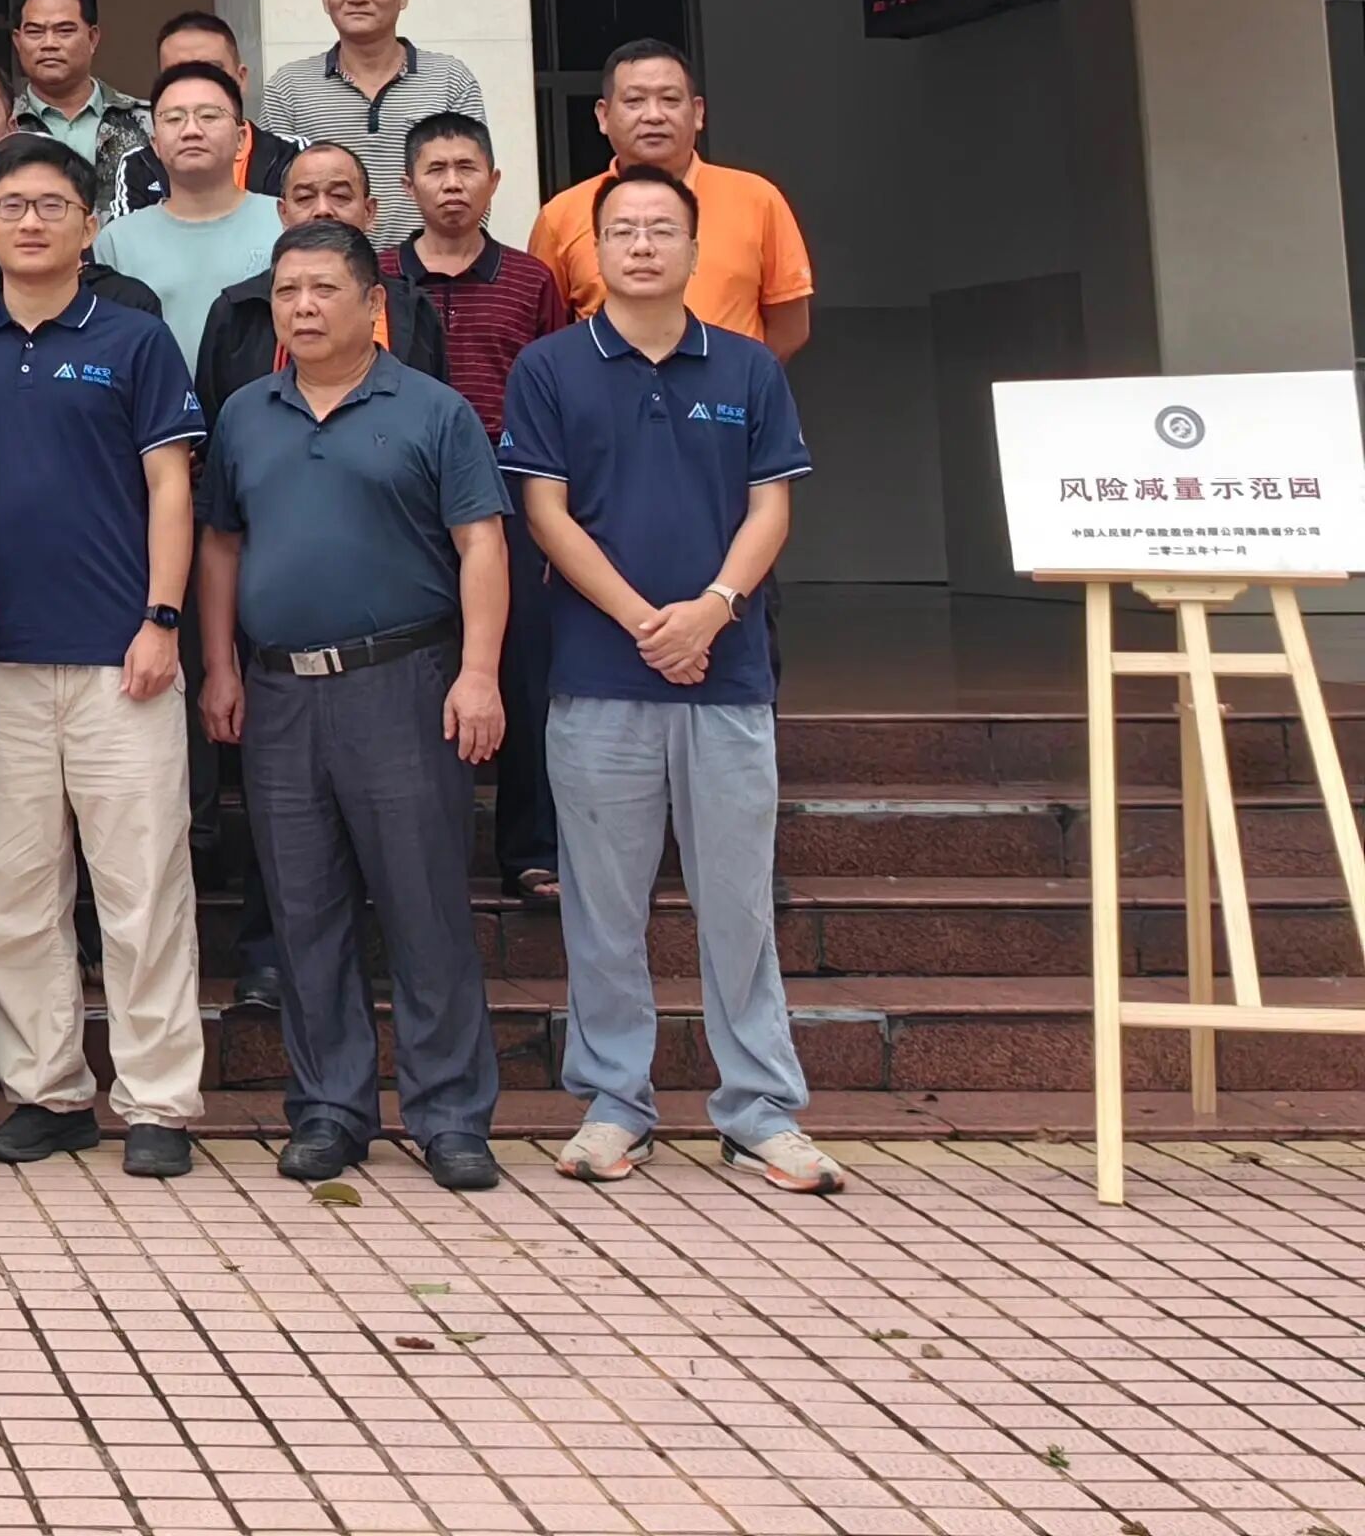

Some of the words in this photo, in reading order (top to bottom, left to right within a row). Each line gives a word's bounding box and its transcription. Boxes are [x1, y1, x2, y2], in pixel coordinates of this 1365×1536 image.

[1060, 476, 1322, 502] 风险减量示范园
[1148, 545, 1247, 556] 二零二五年十一月
